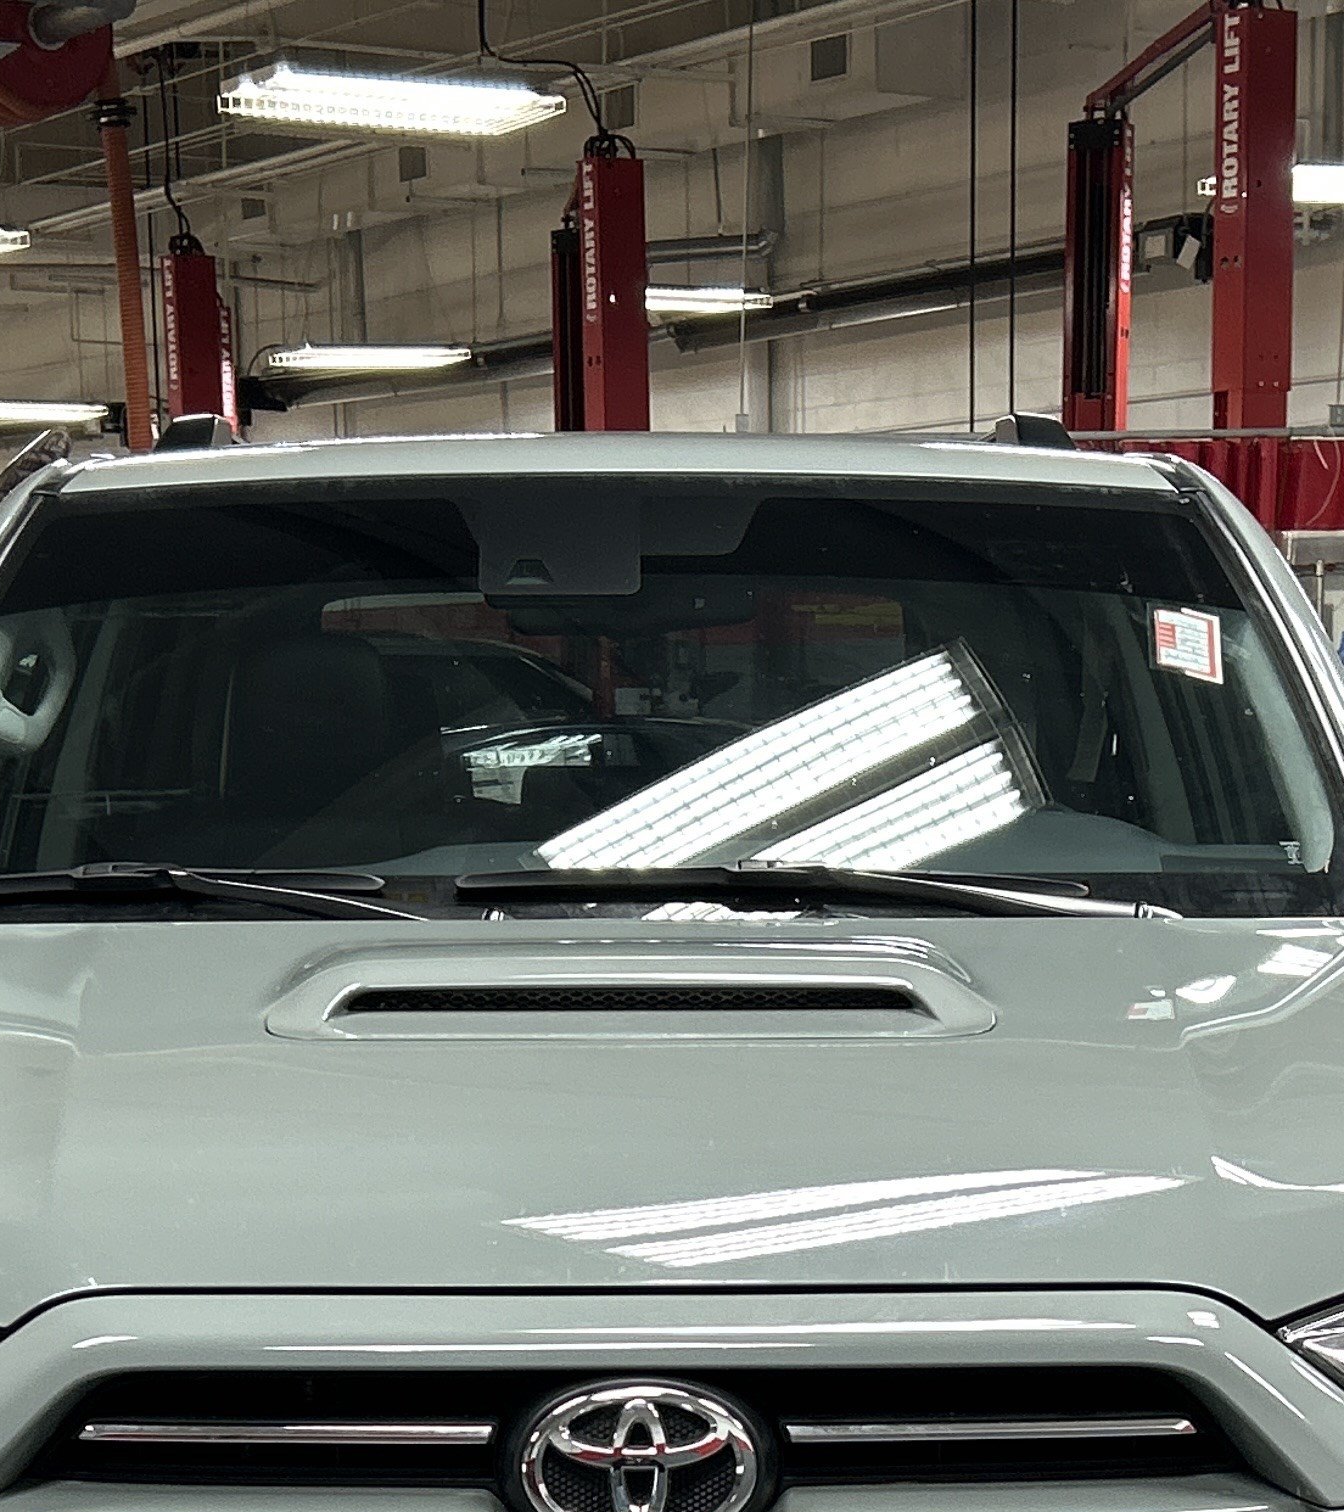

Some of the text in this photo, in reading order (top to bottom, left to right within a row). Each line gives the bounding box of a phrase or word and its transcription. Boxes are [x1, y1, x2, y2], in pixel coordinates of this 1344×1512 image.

[1222, 13, 1241, 198] ROTARY LIFT
[582, 161, 597, 310] ROTARY LIFT
[163, 258, 179, 381] ROTARY LIFT
